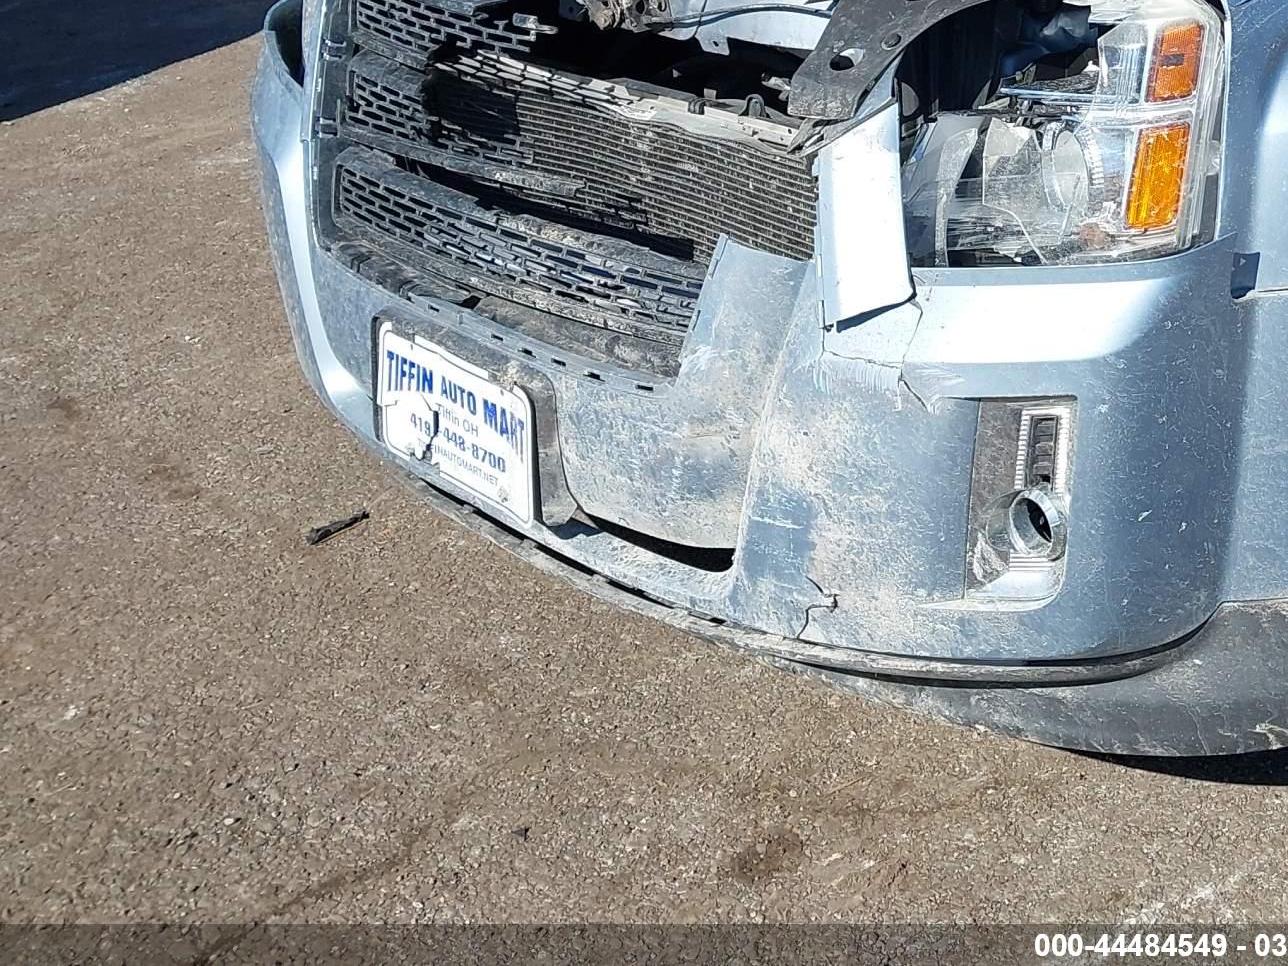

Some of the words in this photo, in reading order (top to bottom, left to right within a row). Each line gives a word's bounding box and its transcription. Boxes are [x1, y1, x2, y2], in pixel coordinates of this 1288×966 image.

[387, 351, 434, 394] TIFFIN
[441, 376, 477, 416] AUTO
[483, 399, 525, 463] MART
[463, 418, 479, 438] OH
